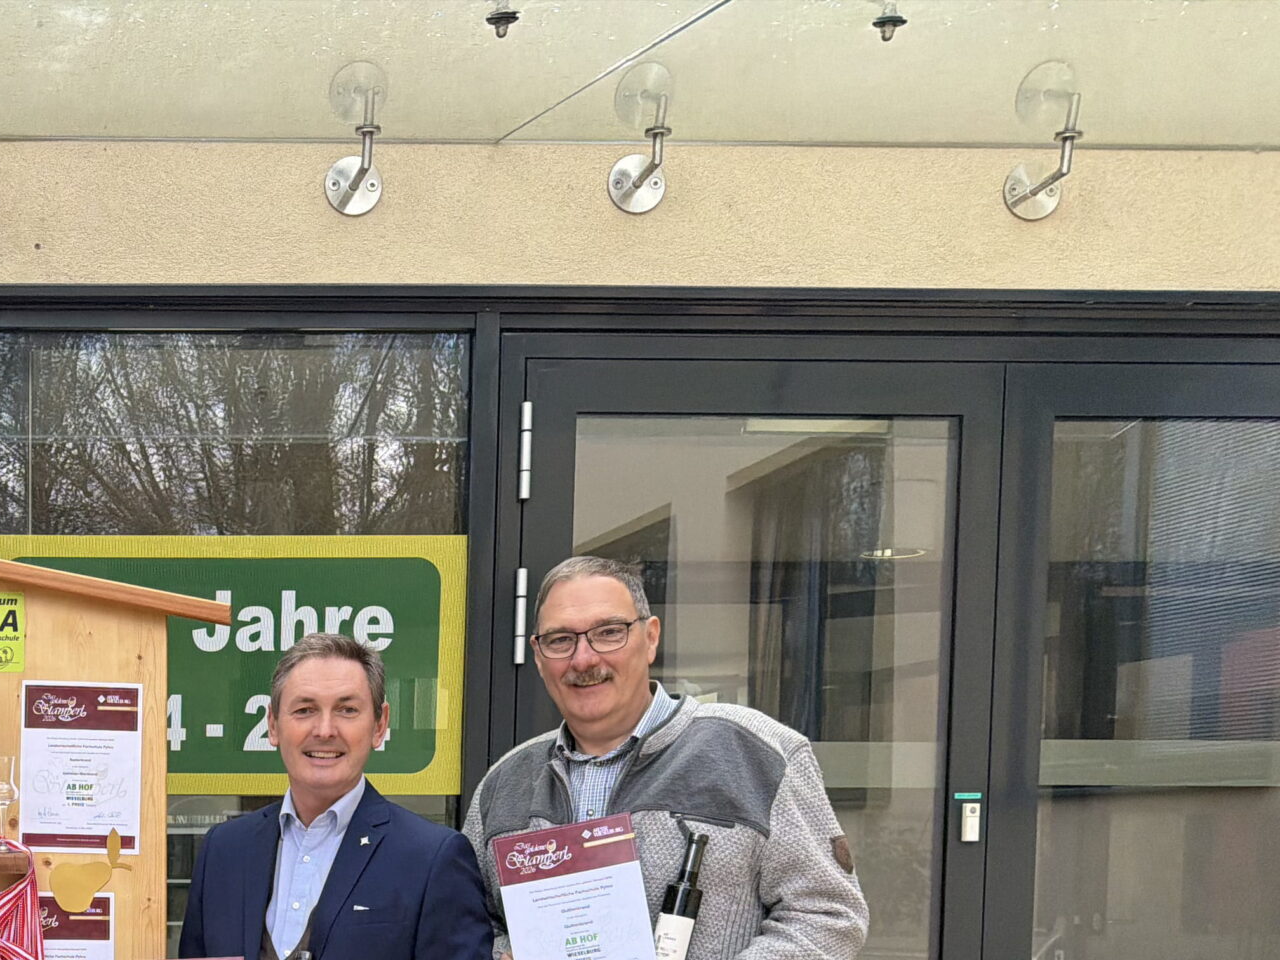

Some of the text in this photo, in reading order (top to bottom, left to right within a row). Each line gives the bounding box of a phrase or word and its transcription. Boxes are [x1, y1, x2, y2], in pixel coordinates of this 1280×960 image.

[191, 590, 395, 652] Jahre
[32, 700, 87, 718] Stamperl
[506, 846, 572, 869] Stamperl
[565, 933, 600, 946] AB HOF
[567, 948, 601, 958] WIESELBURG
